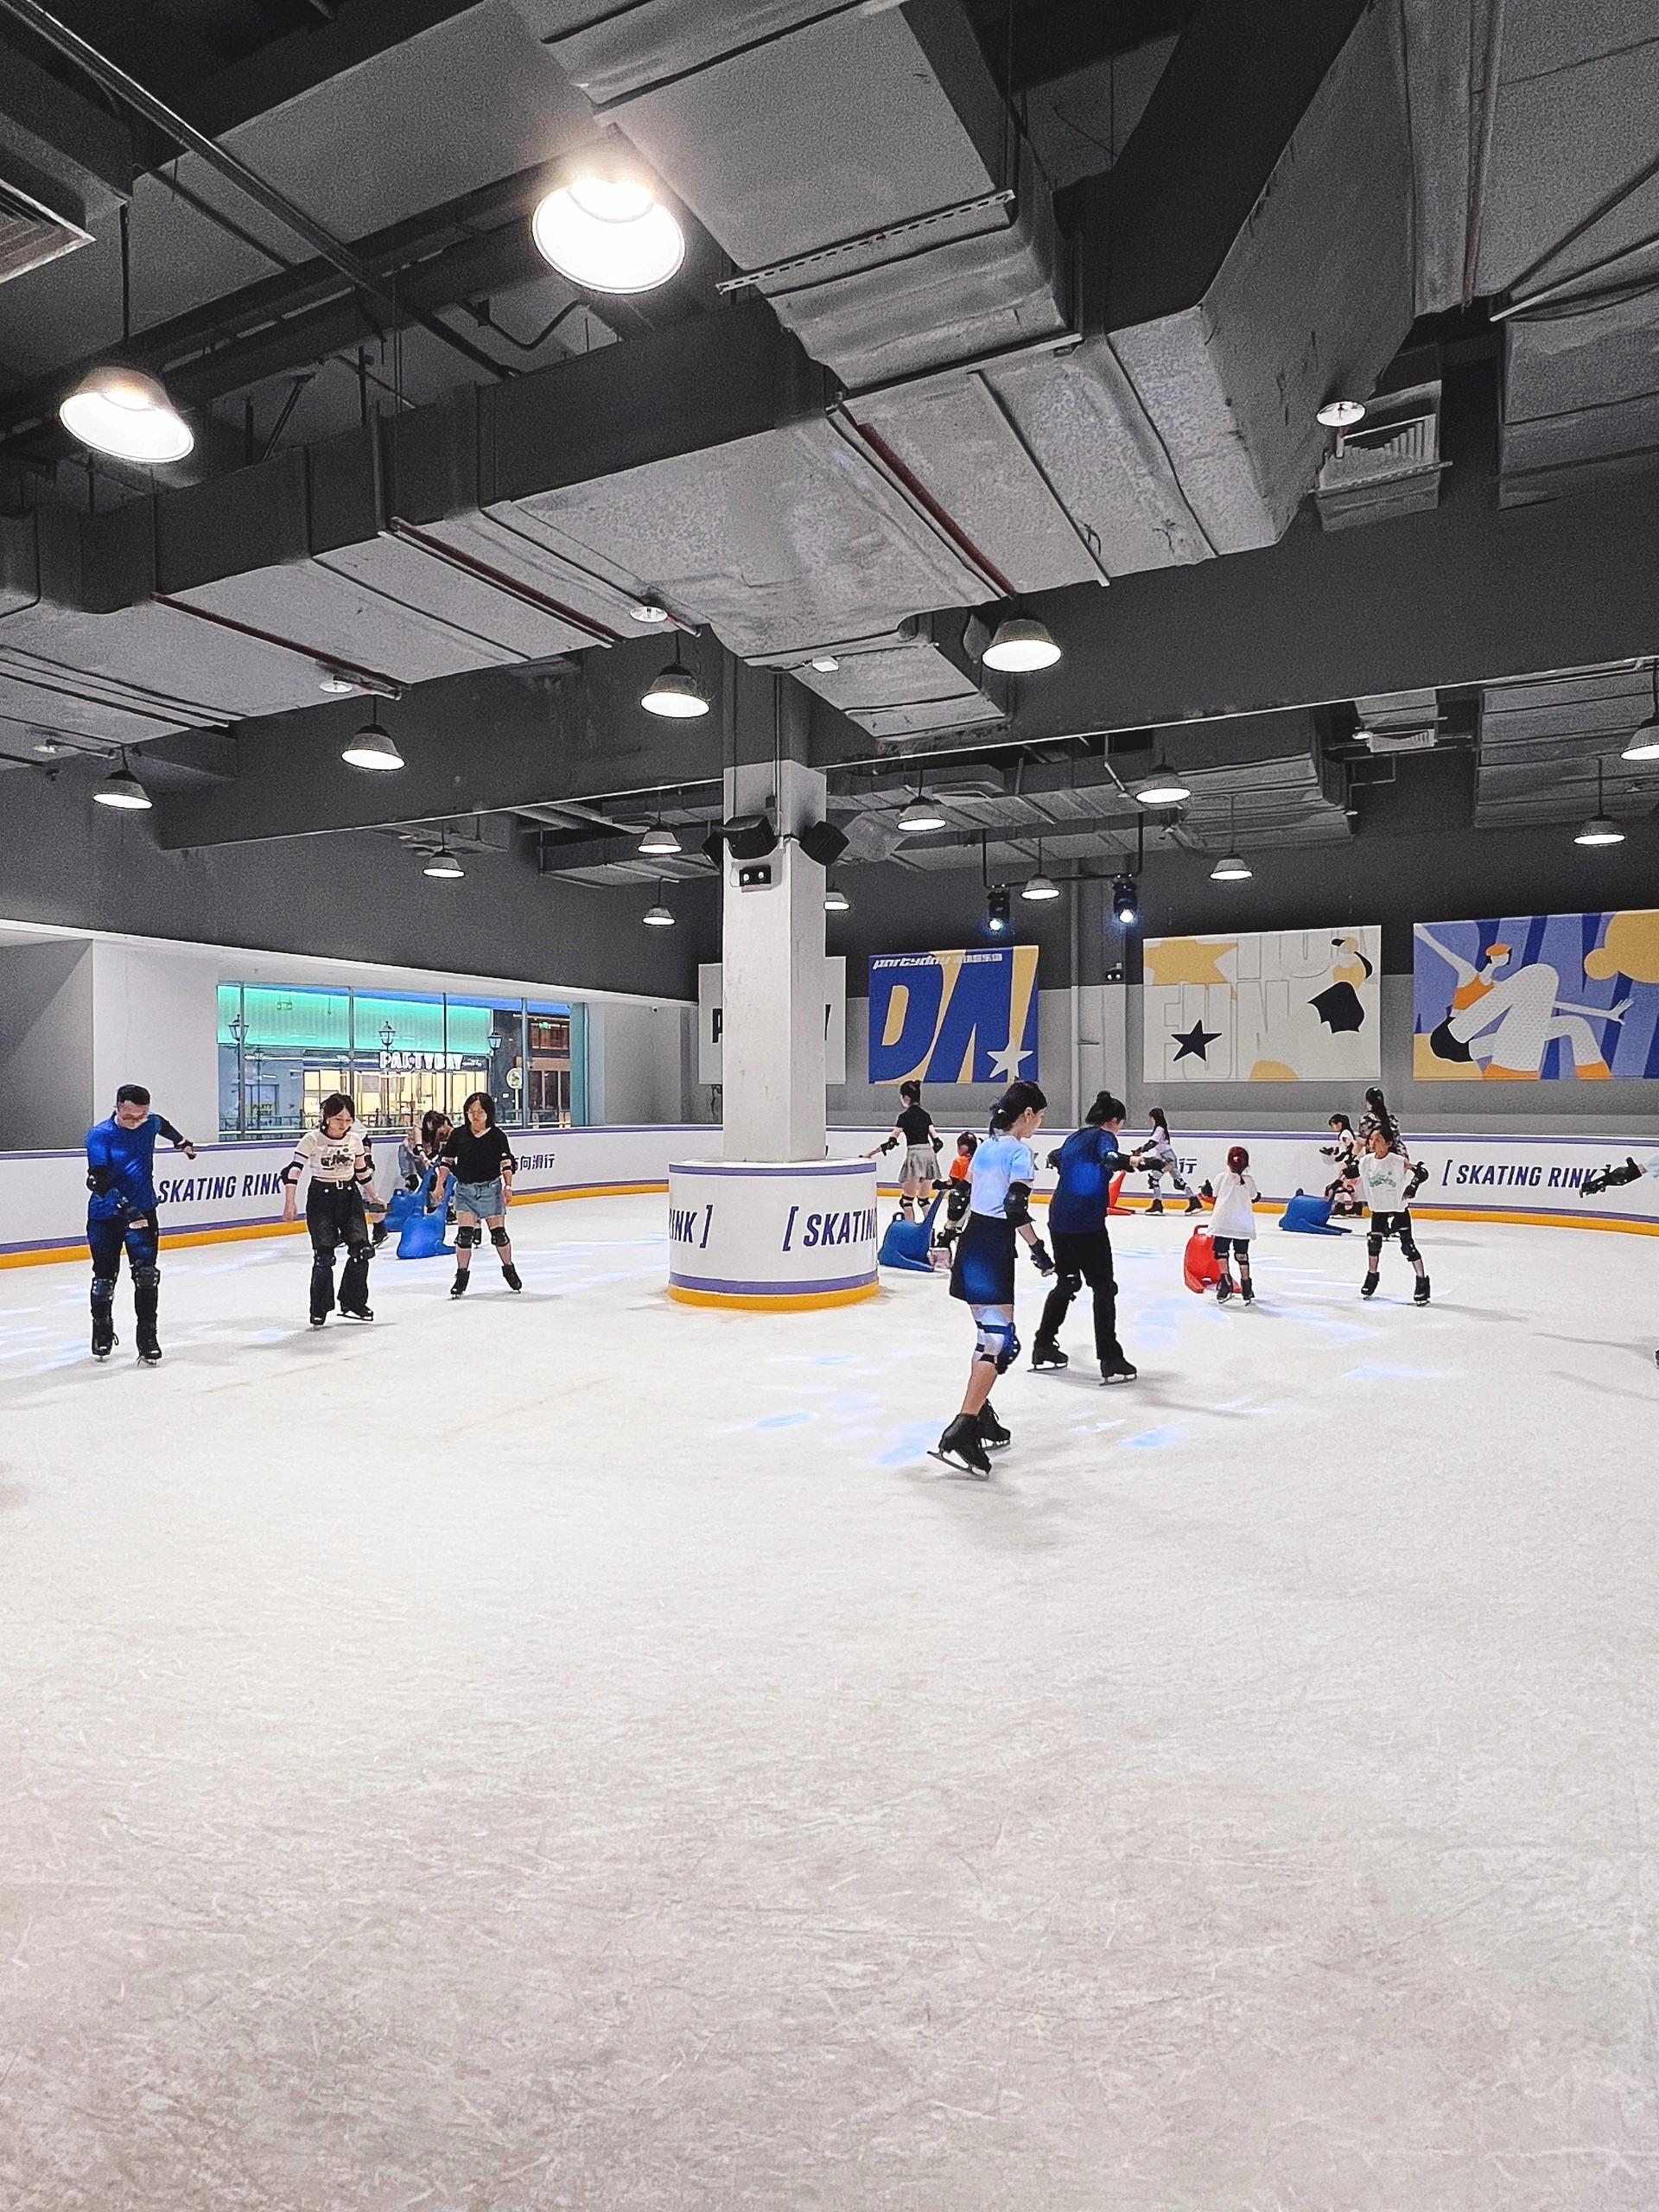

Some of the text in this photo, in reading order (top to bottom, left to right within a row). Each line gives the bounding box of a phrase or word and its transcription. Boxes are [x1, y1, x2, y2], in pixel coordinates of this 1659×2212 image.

[158, 1173, 282, 1204] SKATING RINK
[1456, 1165, 1542, 1186] SKATING
[1548, 1167, 1598, 1188] RINK
